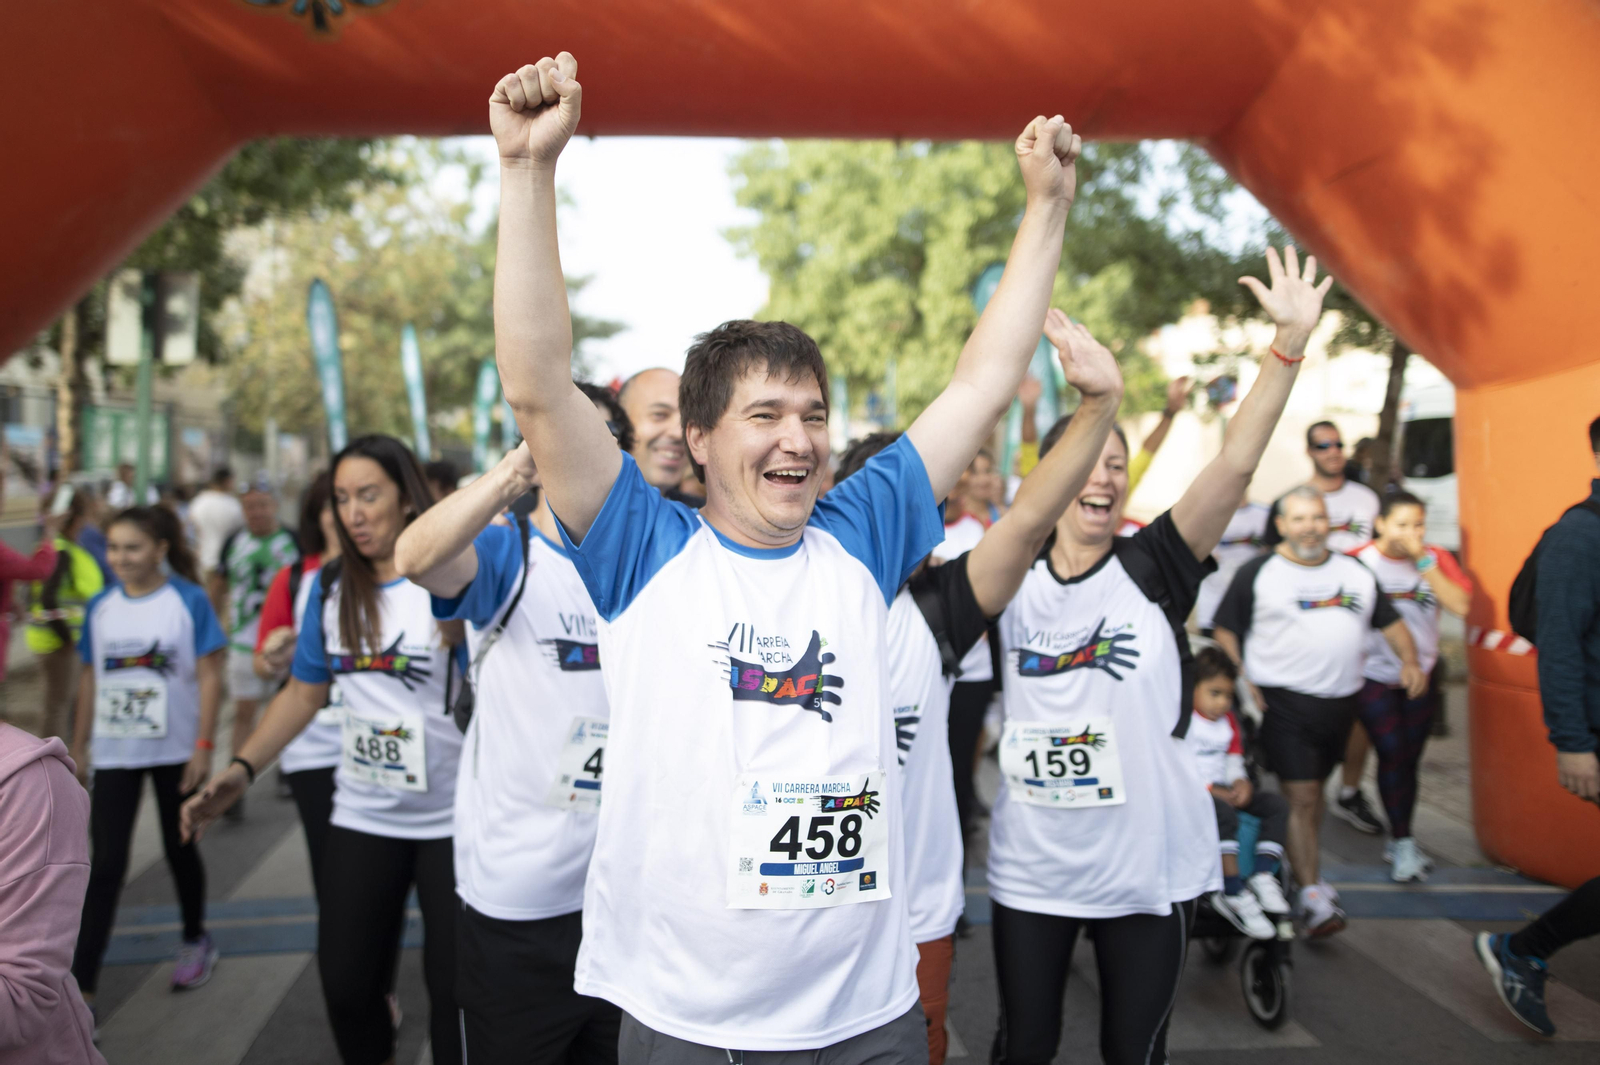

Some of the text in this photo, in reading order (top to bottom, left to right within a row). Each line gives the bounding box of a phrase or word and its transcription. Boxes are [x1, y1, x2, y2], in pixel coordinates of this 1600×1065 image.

[564, 645, 600, 664] AS
[758, 649, 794, 664] ARCHA
[355, 735, 401, 763] 488
[1025, 748, 1091, 778] 159
[772, 782, 851, 794] VII CARRERA MARCHA
[742, 803, 767, 811] ASPACE
[824, 794, 871, 809] ASPACE
[769, 813, 863, 861] 458
[793, 861, 840, 875] MIGUEL ANGEL
